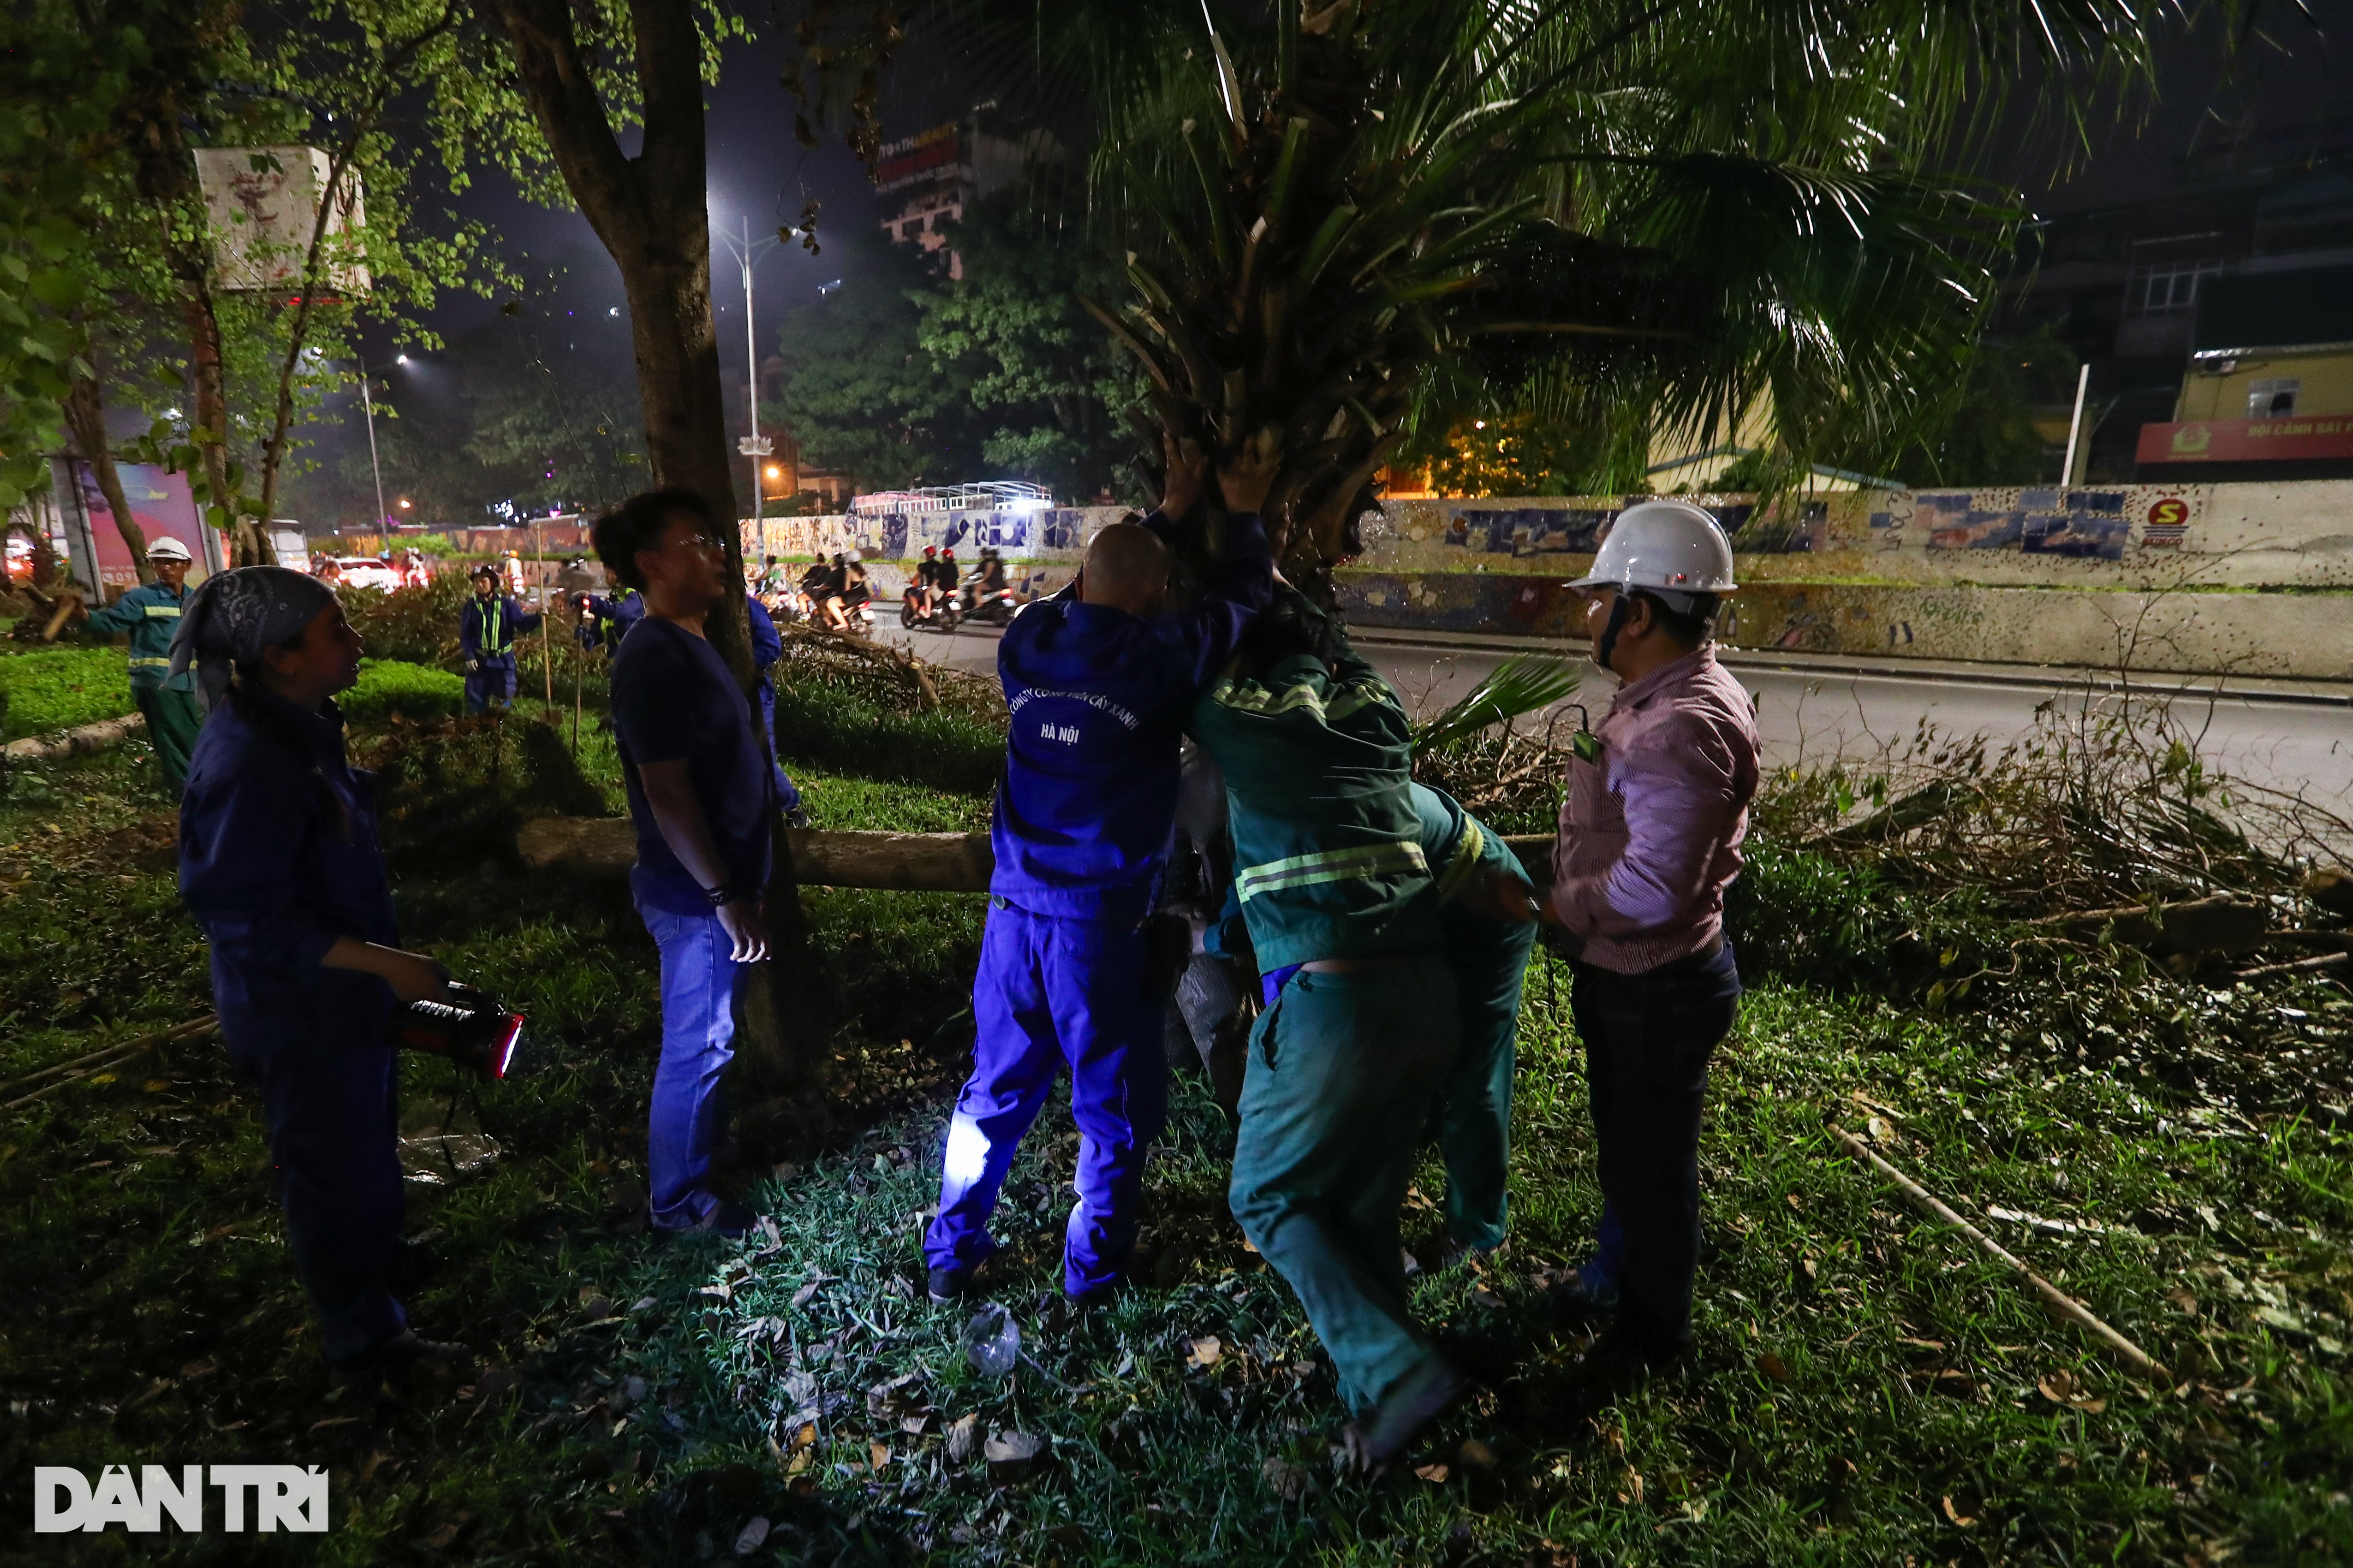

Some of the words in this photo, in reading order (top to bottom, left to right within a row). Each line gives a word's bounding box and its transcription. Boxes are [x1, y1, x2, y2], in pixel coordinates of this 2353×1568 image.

[2156, 504, 2181, 523] S
[1010, 693, 1028, 714] CÔNG
[1024, 688, 1035, 700] TY
[1089, 694, 1111, 710] CÂY
[1108, 703, 1140, 731] XANH
[1040, 722, 1056, 740] HÀ
[1058, 725, 1079, 746] NỘI
